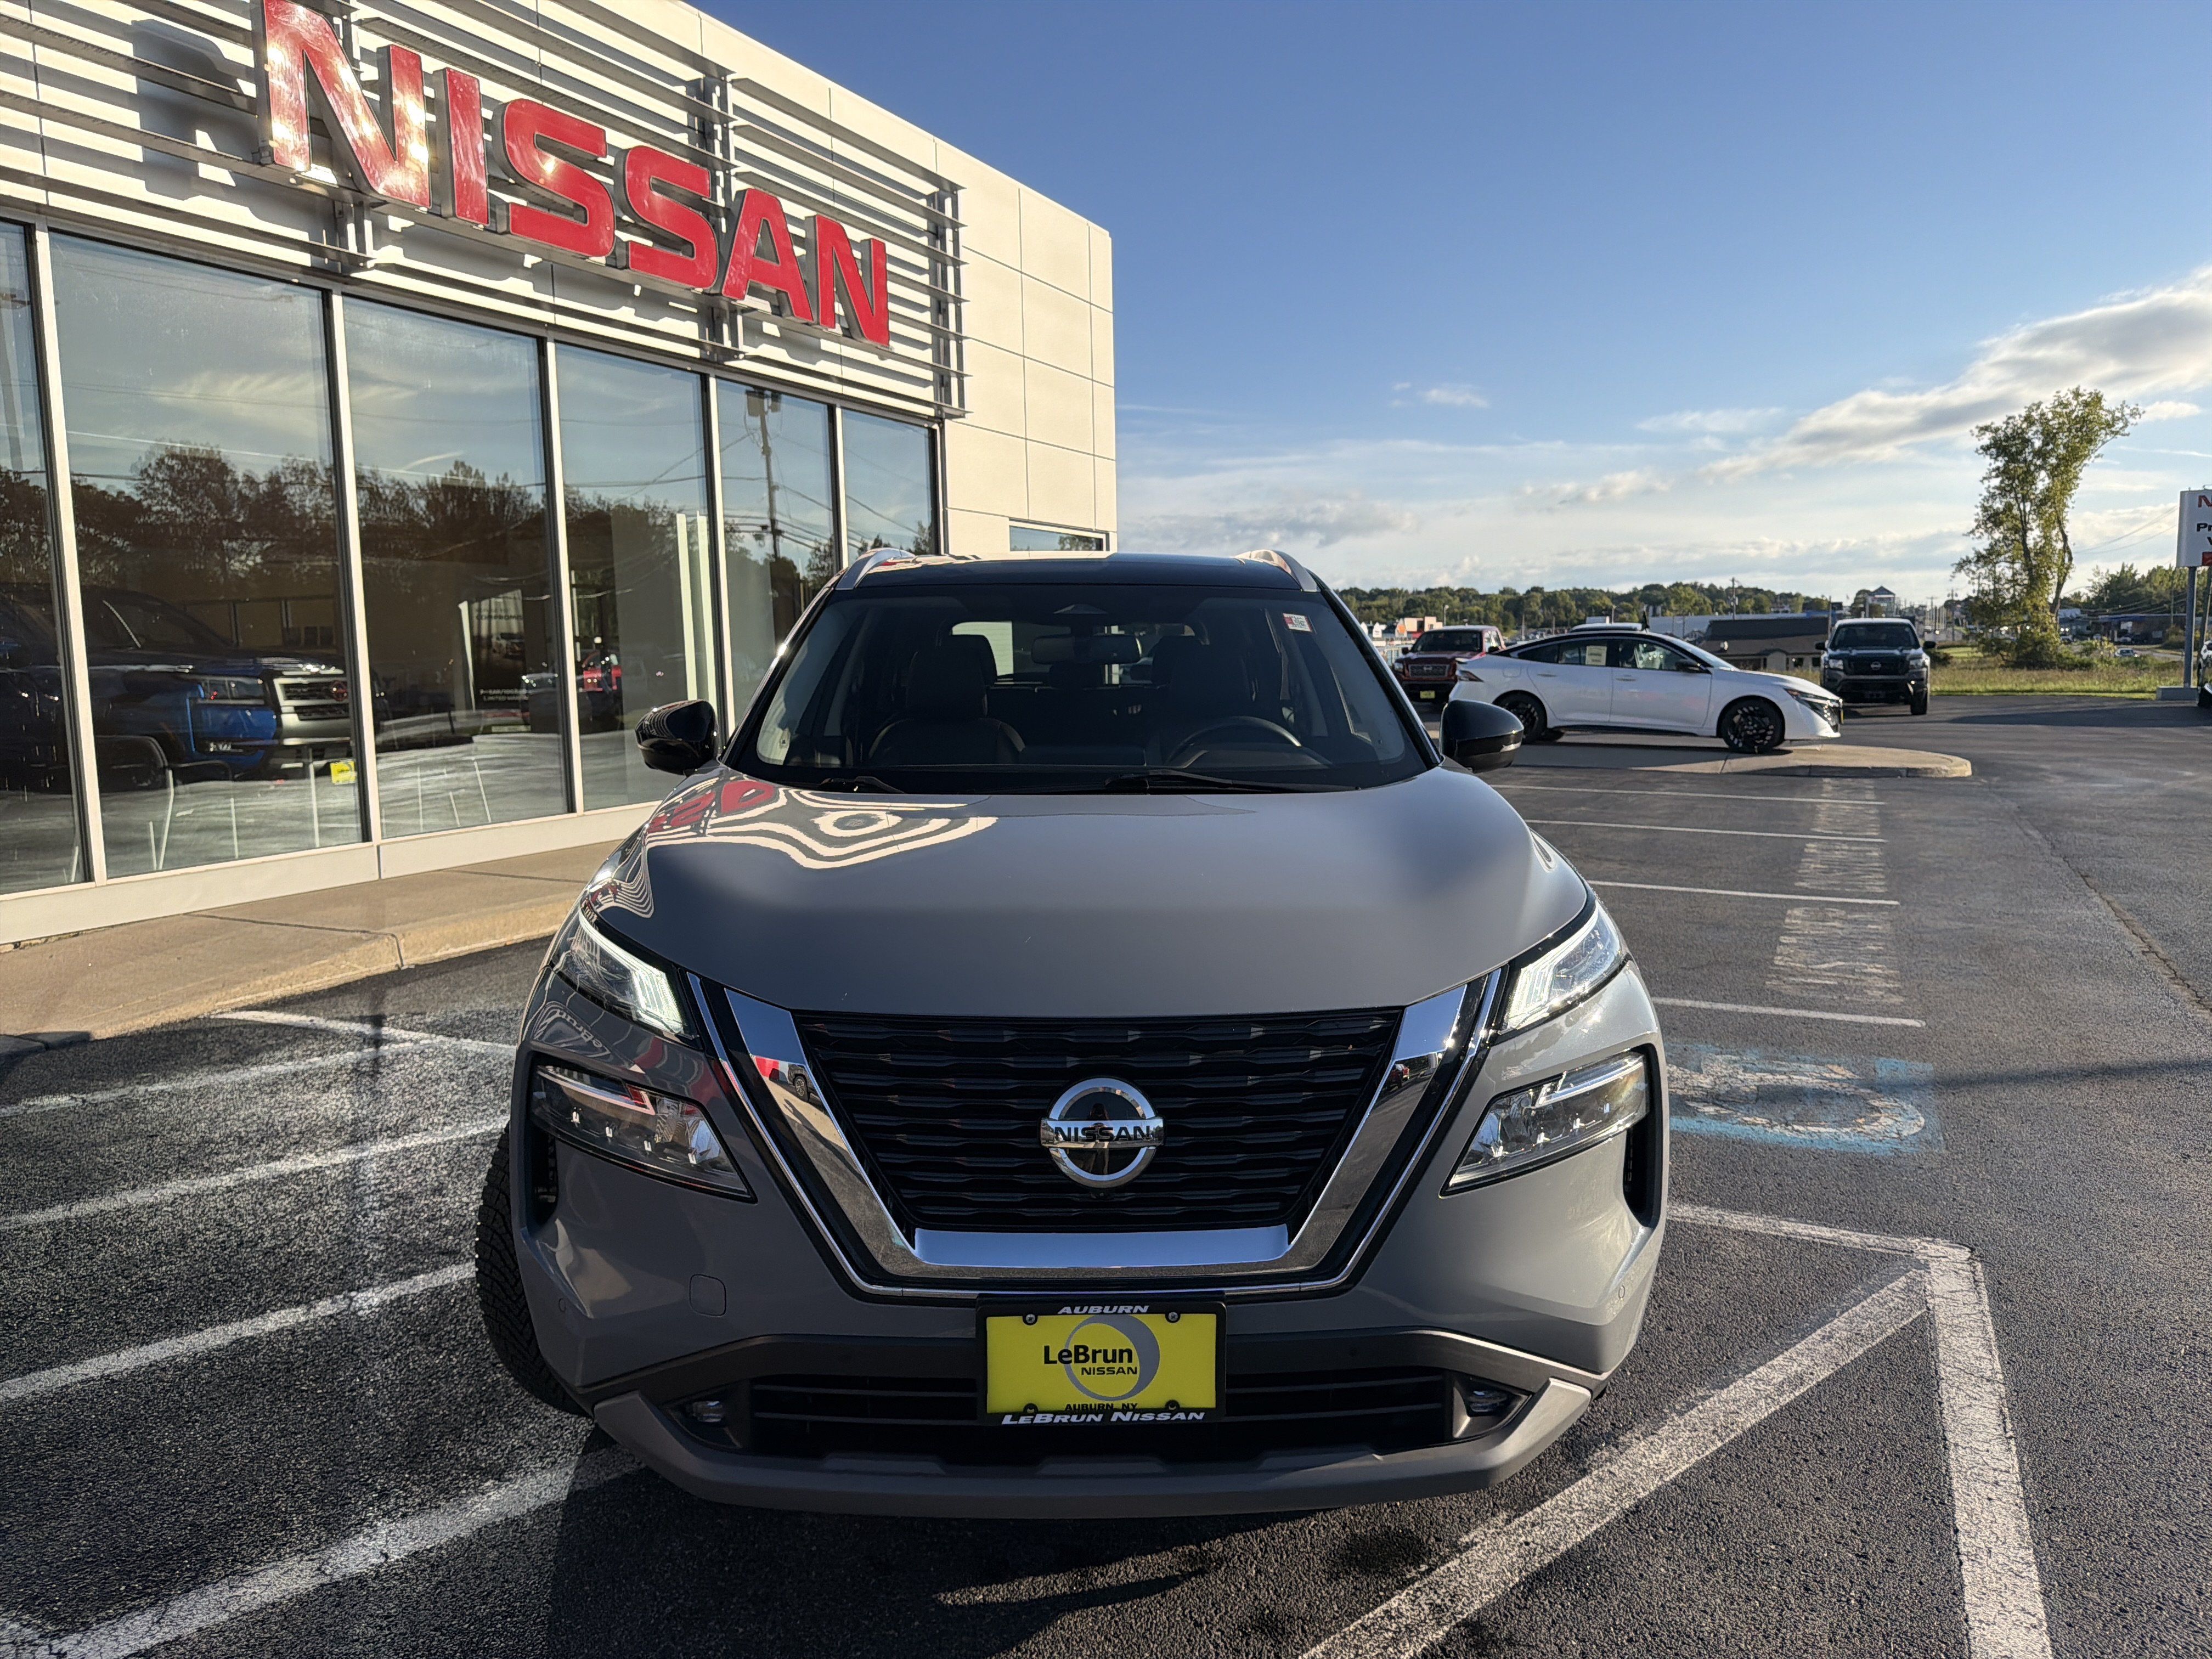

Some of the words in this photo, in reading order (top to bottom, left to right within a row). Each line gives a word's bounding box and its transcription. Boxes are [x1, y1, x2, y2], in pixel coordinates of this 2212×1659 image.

[261, 0, 890, 347] NISSAN
[1054, 1125, 1151, 1142] NISSAN
[1058, 1305, 1149, 1314] AUBURN
[1043, 1345, 1133, 1364] LeBrun
[1081, 1366, 1137, 1375] NISSAN
[1121, 1403, 1138, 1411] NY
